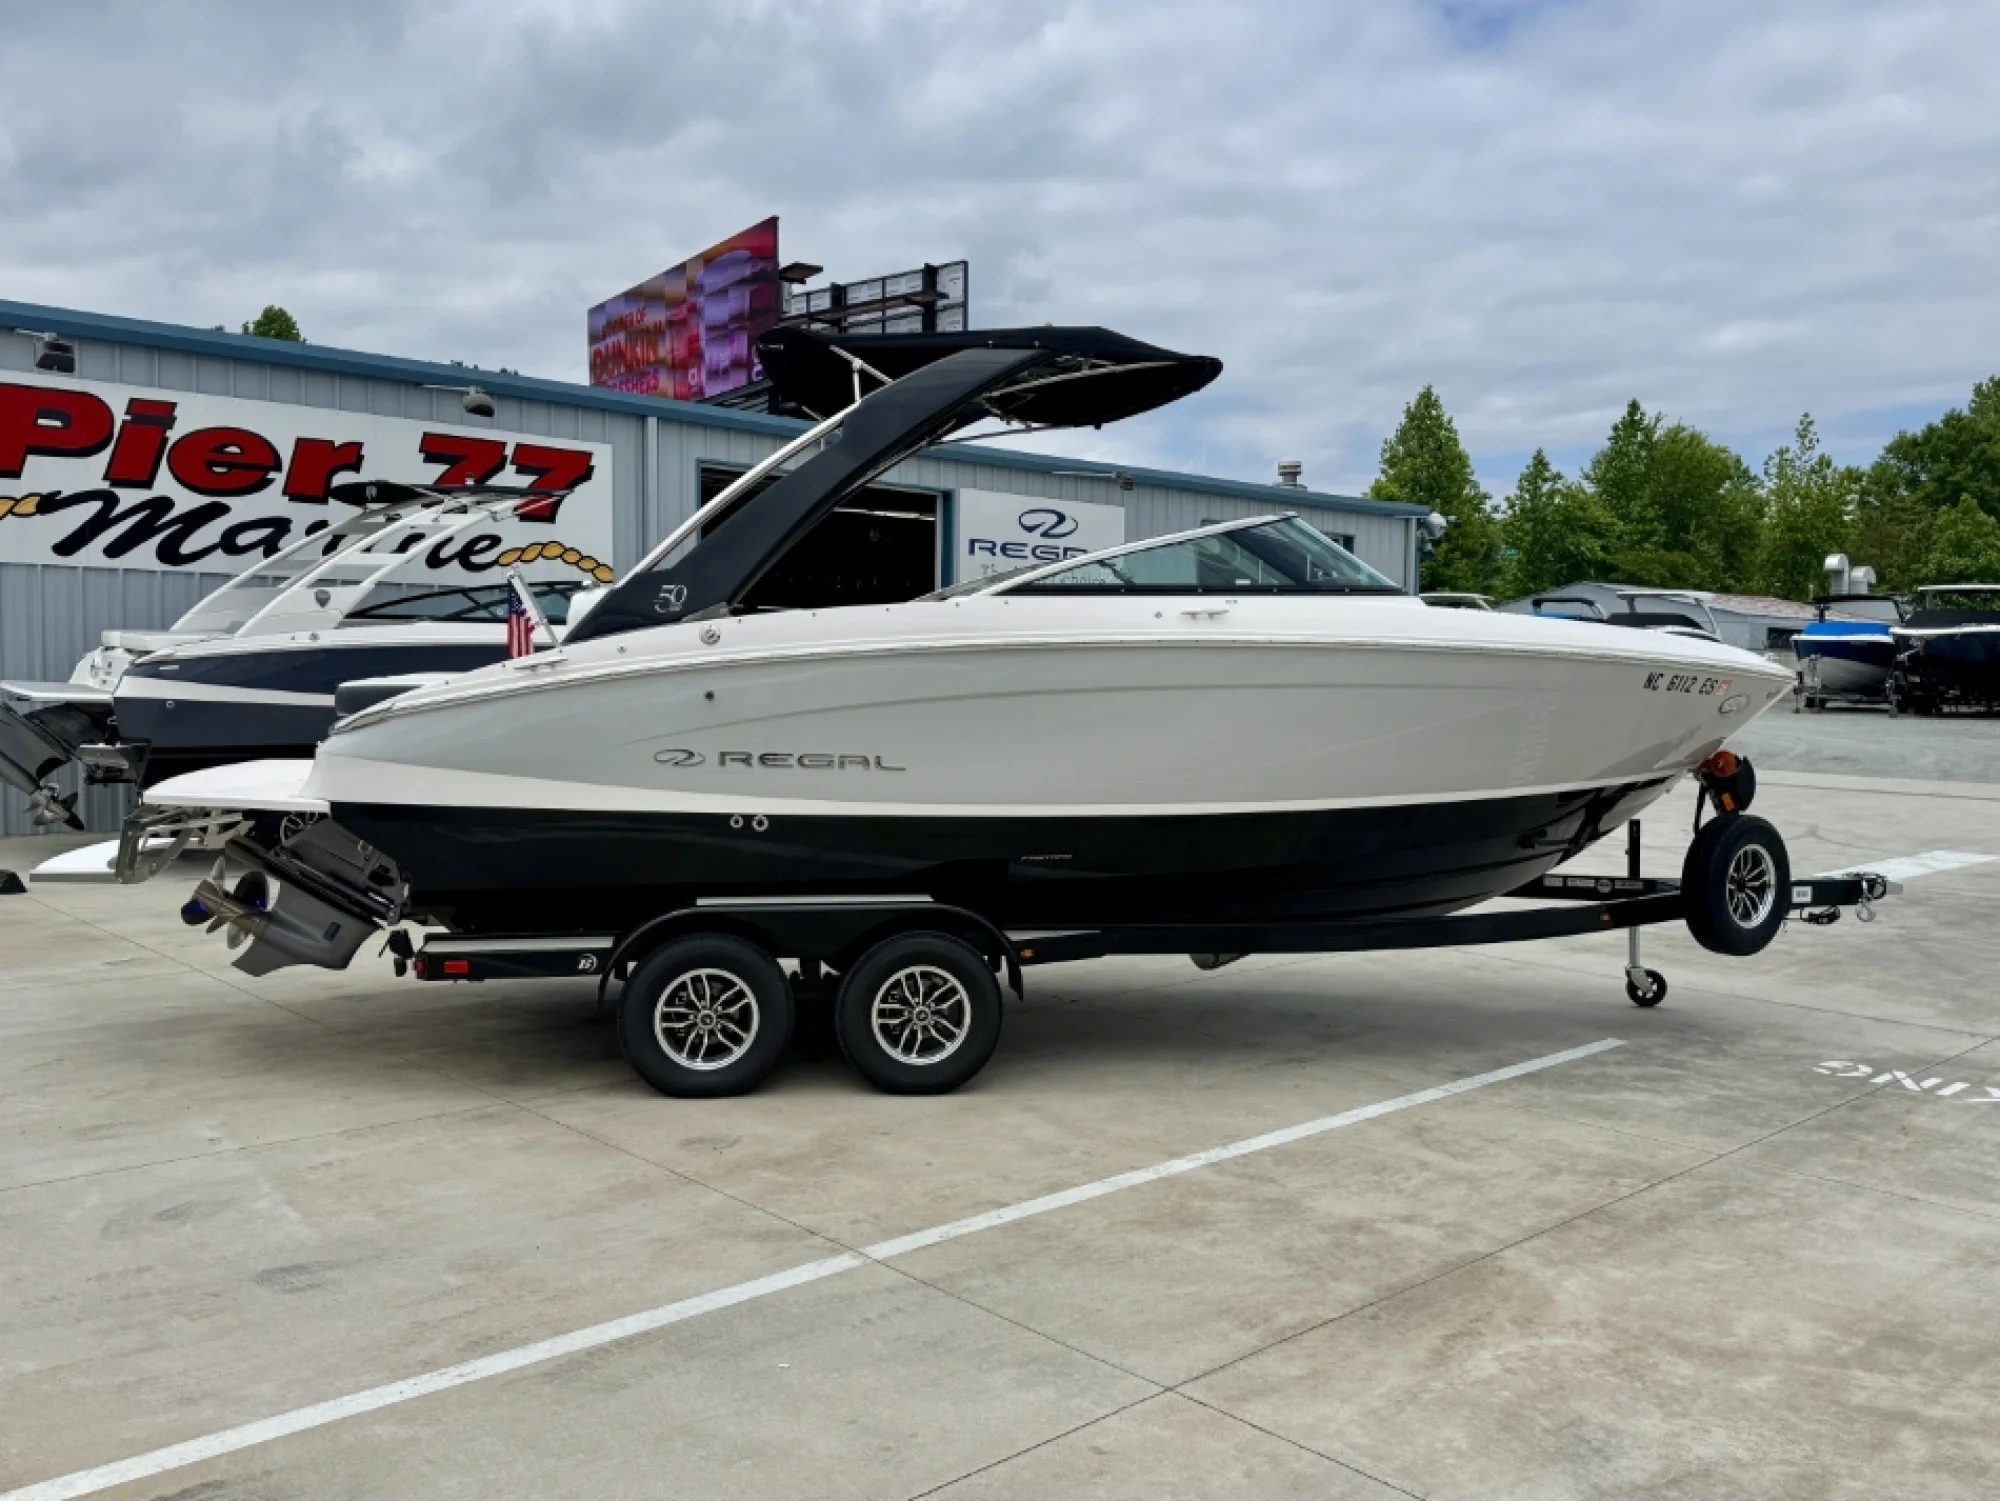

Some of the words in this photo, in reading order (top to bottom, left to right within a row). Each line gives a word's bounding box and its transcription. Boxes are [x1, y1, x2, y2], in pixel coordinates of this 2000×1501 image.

[0, 382, 364, 504] Pier
[419, 431, 596, 524] 77
[38, 489, 503, 572] Marne
[968, 538, 1090, 562] REGA
[1643, 671, 1664, 691] NC
[1667, 674, 1698, 694] 6112
[718, 750, 907, 772] REGAL
